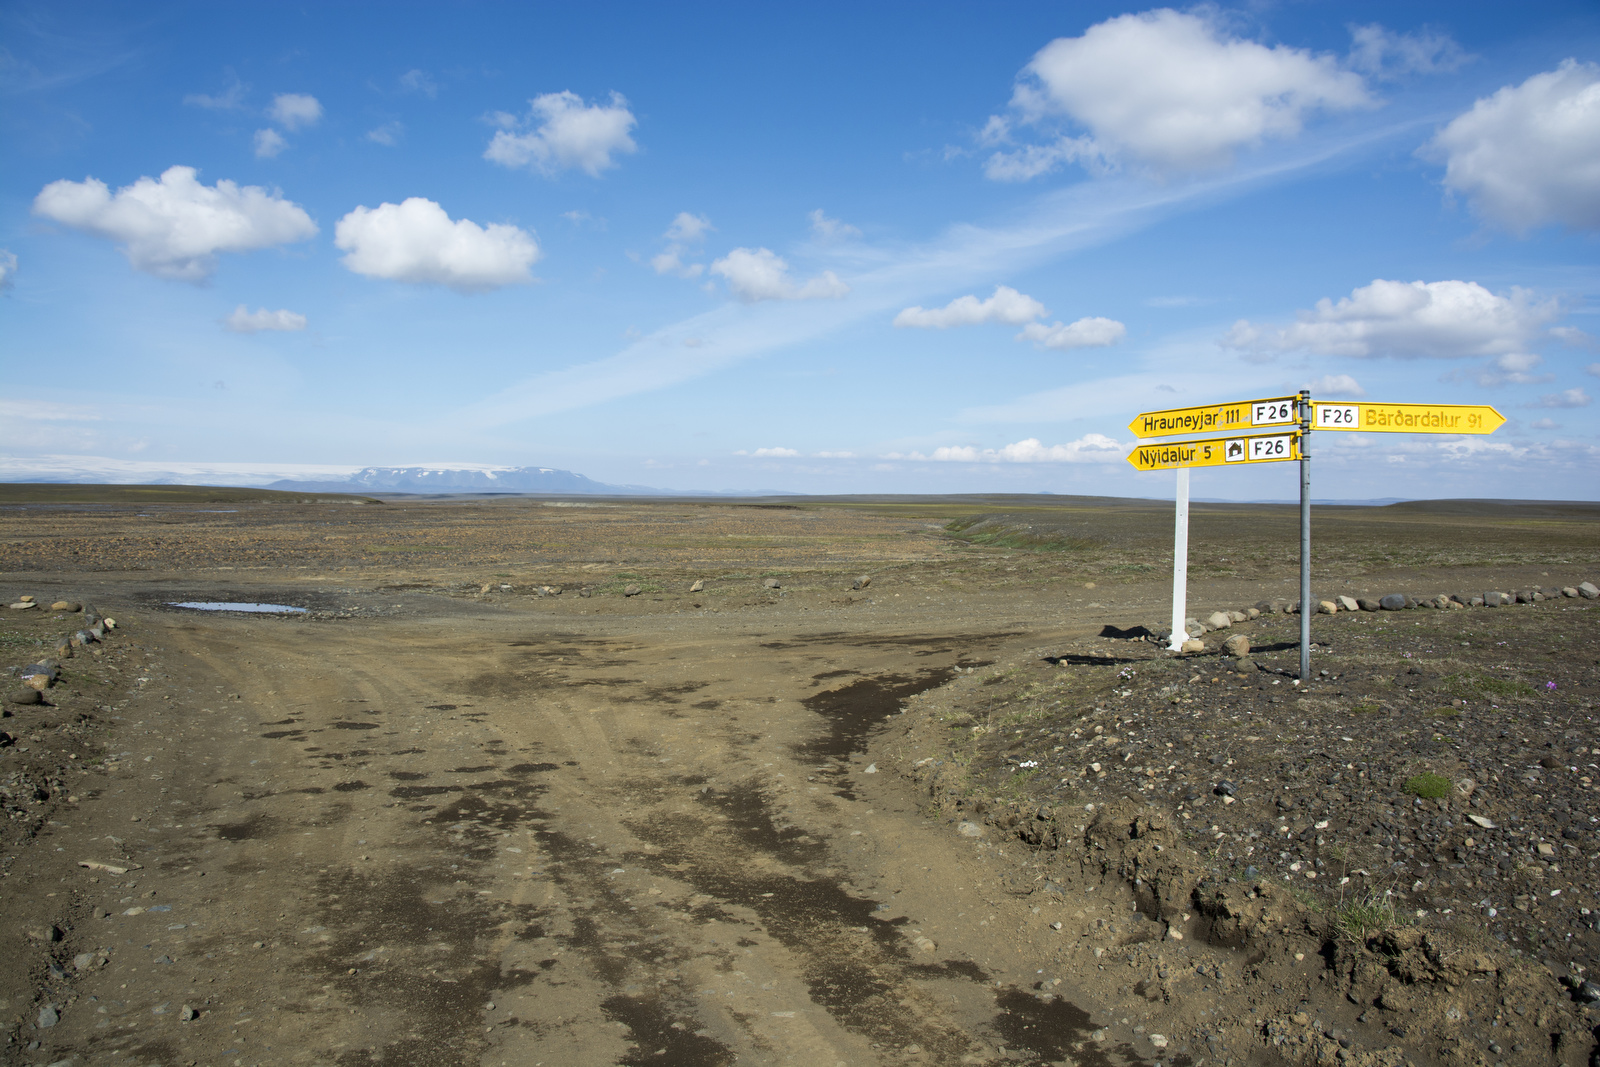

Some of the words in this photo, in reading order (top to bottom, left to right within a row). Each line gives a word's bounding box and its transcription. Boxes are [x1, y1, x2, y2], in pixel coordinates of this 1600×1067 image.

[1144, 411, 1219, 432] Hrauneyjar
[1226, 409, 1240, 424] 111
[1256, 404, 1289, 421] F26
[1322, 409, 1353, 423] F26
[1365, 409, 1461, 428] Bárðardalur
[1467, 413, 1482, 428] 91
[1204, 446, 1212, 459] 5
[1254, 440, 1284, 456] F26
